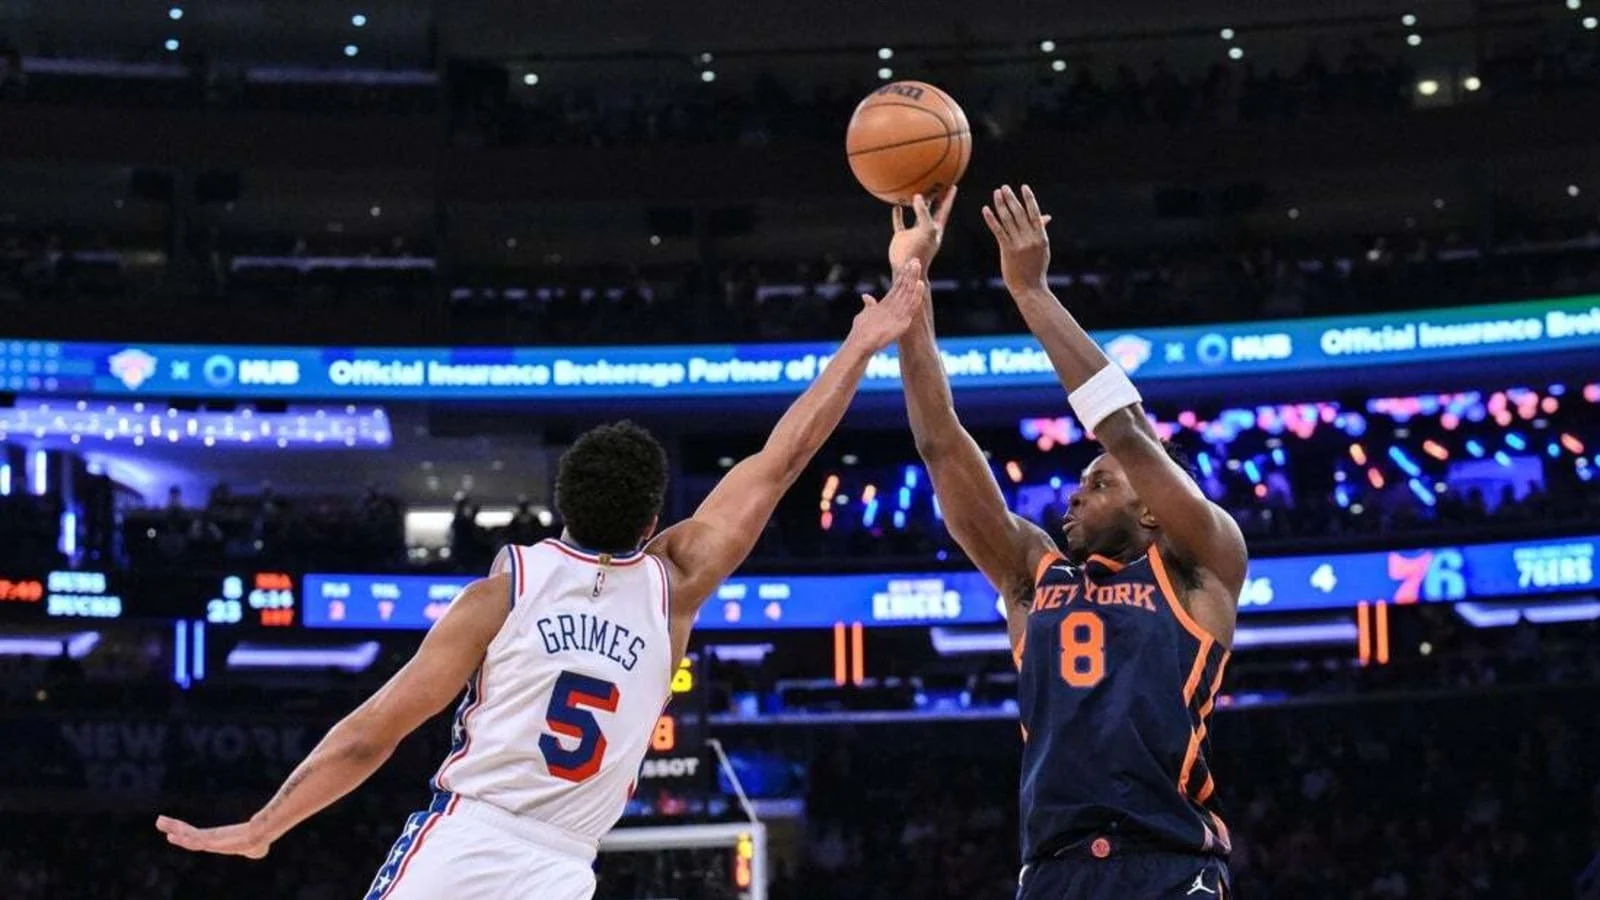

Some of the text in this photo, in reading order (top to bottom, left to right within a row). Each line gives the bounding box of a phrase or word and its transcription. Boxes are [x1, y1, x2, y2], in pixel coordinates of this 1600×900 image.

[1320, 323, 1416, 355] Official
[1418, 318, 1543, 349] Insurance
[329, 359, 424, 386] Official
[428, 359, 550, 386] Insurance
[553, 359, 685, 387] Brokerage
[688, 357, 783, 383] Partner
[785, 354, 816, 381] of
[1084, 577, 1157, 613] YORK
[1310, 563, 1337, 593] 4
[1388, 550, 1466, 604] 76
[537, 614, 645, 671] GRIMES
[1060, 611, 1106, 687] 8
[538, 670, 620, 783] 5
